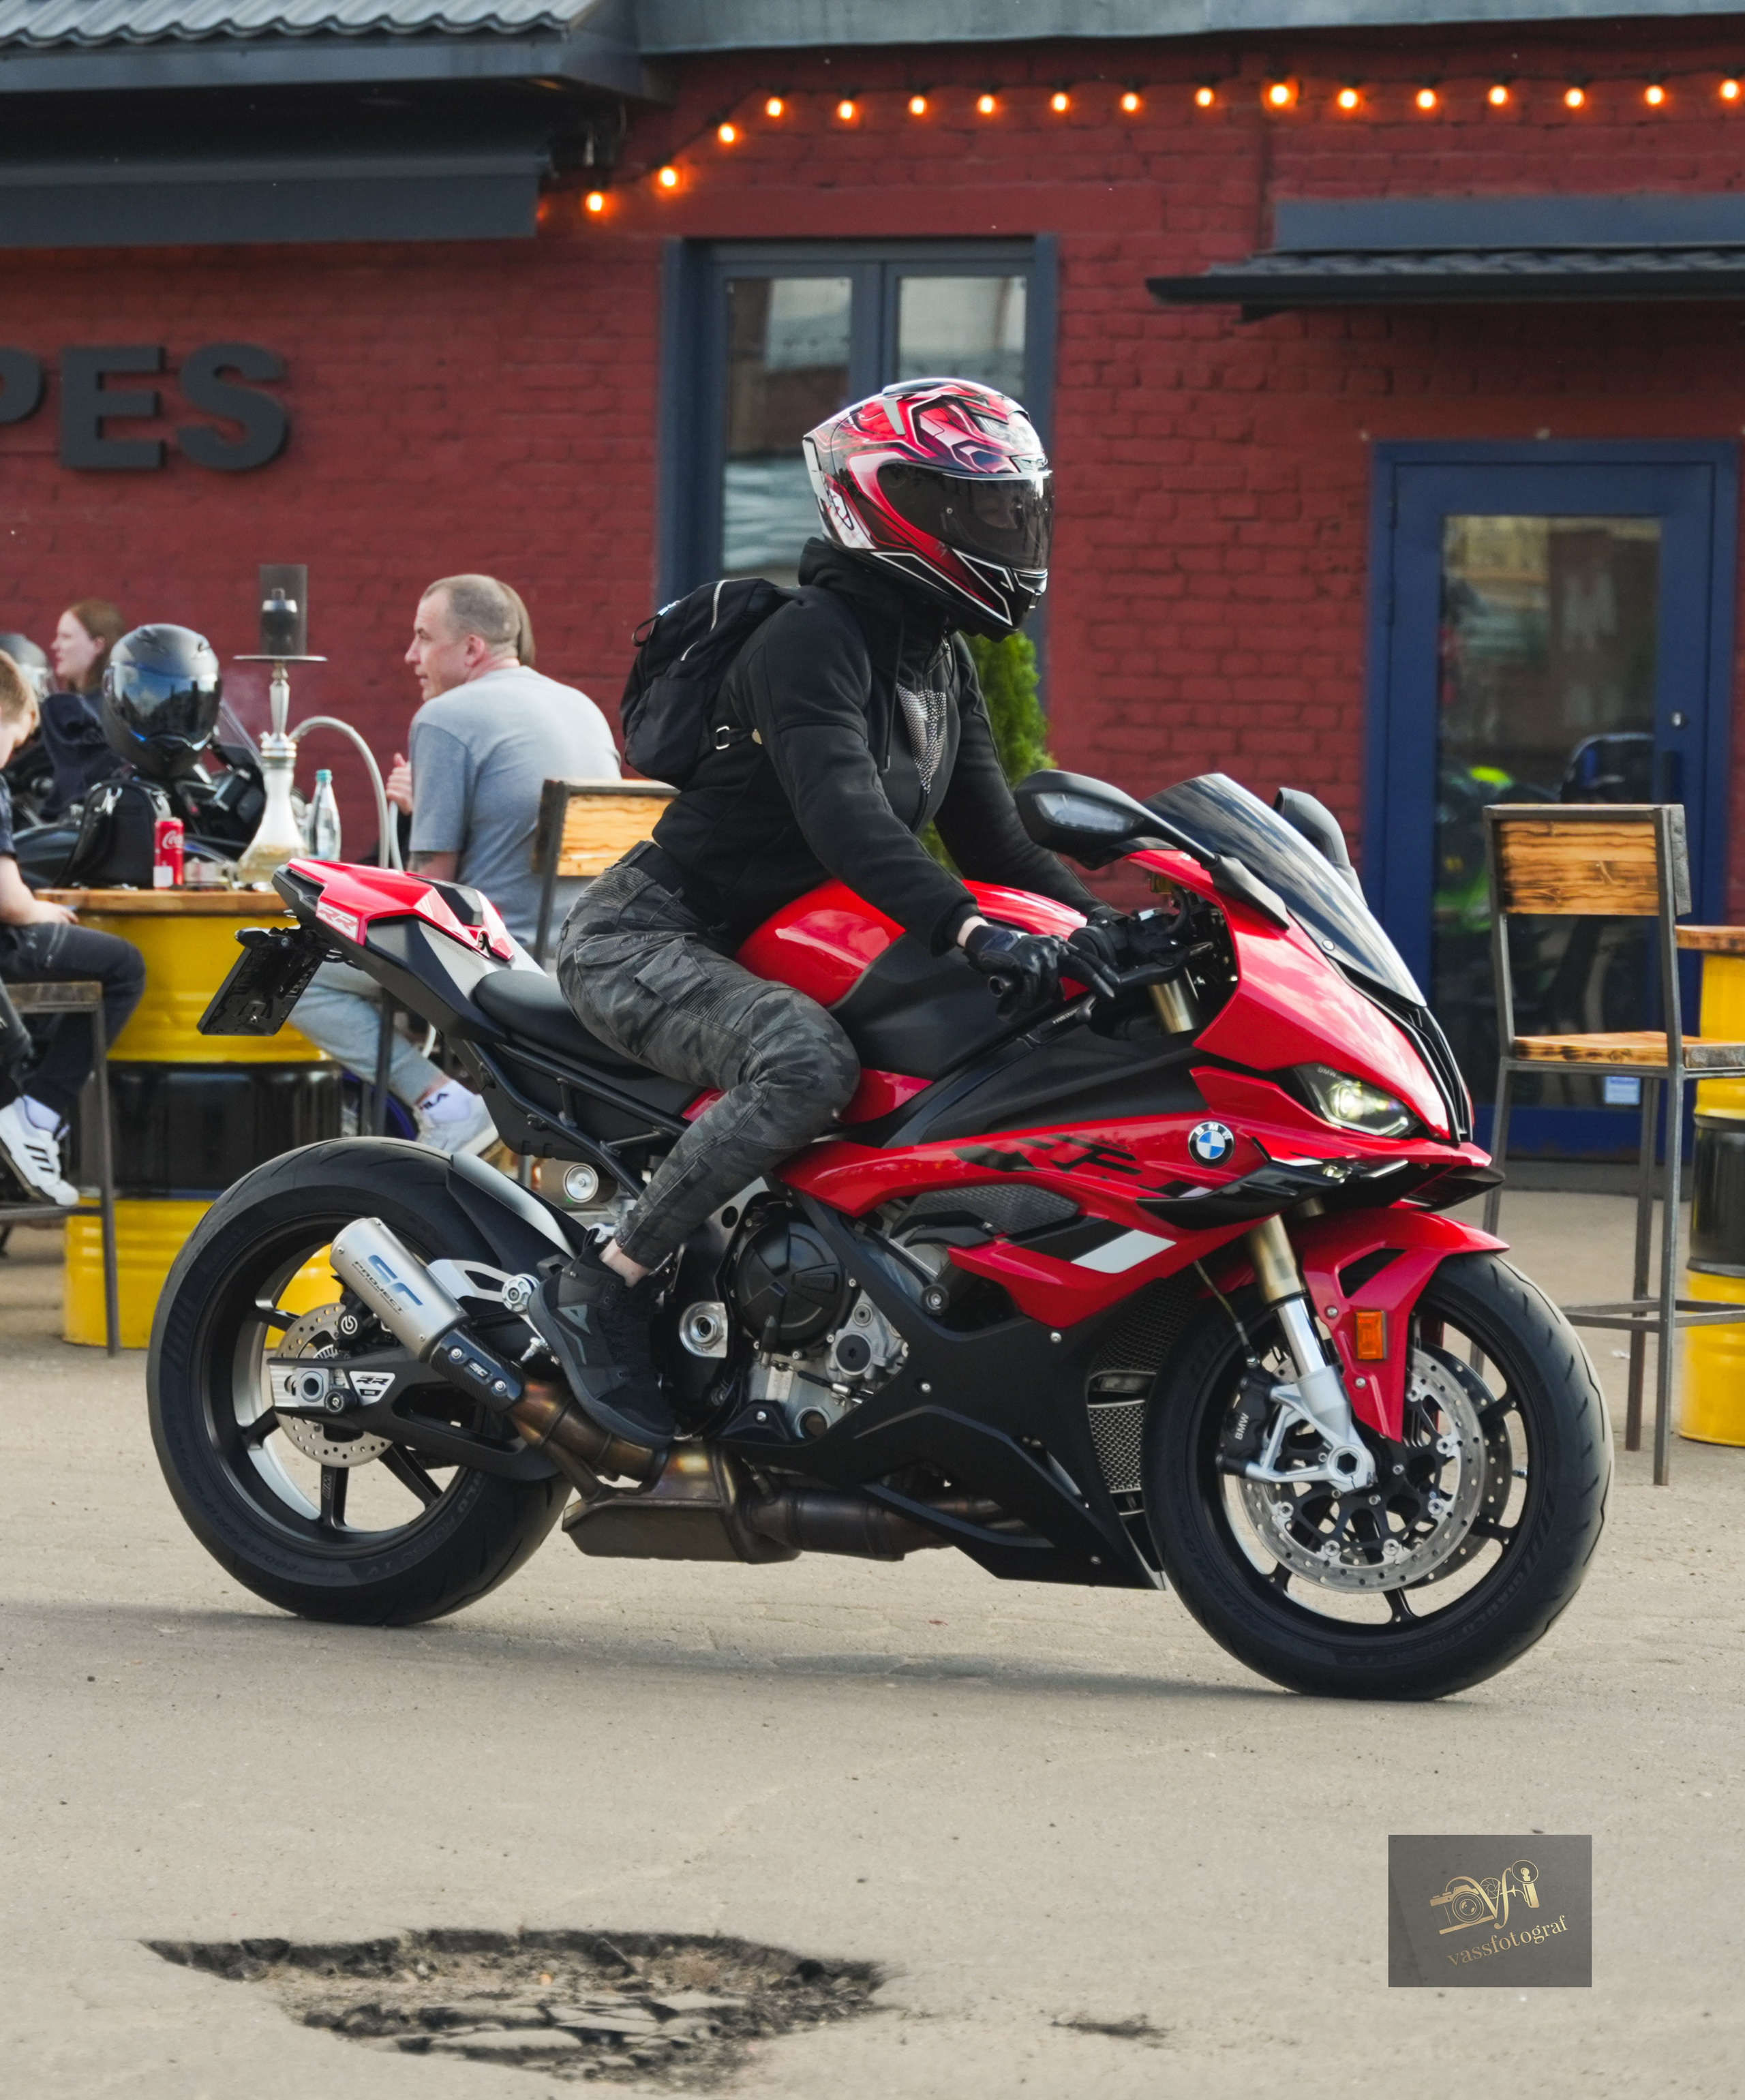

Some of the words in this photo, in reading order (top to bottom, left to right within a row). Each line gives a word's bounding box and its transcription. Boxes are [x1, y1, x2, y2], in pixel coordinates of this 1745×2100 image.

[318, 907, 358, 930] RR
[1318, 1066, 1337, 1078] BMW
[1194, 1123, 1232, 1140] BMW
[354, 1261, 405, 1313] PROJECT
[1234, 1412, 1249, 1440] BMW
